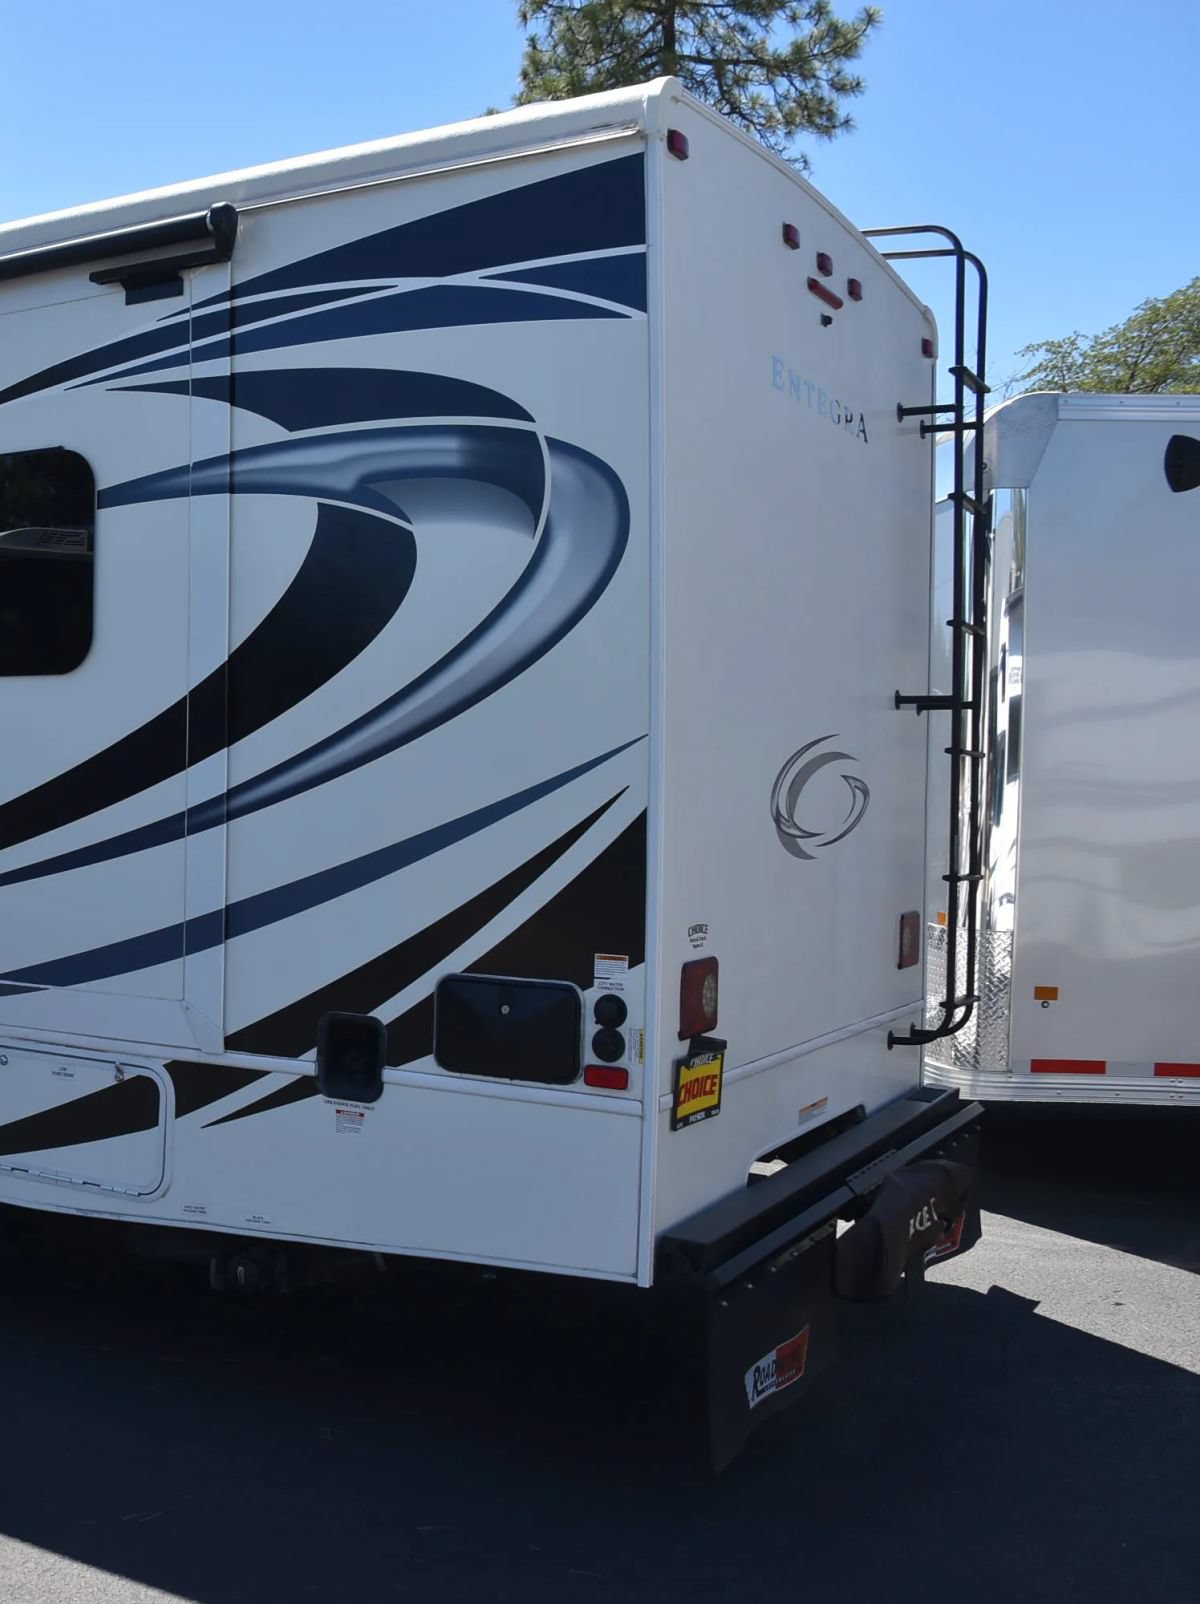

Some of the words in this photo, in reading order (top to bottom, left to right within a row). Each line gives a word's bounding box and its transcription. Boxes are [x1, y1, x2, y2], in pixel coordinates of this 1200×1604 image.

[771, 353, 868, 444] ENTEGRA
[687, 923, 709, 937] CHOICE
[676, 1073, 719, 1107] CHOICE
[751, 1359, 777, 1402] ROAD
